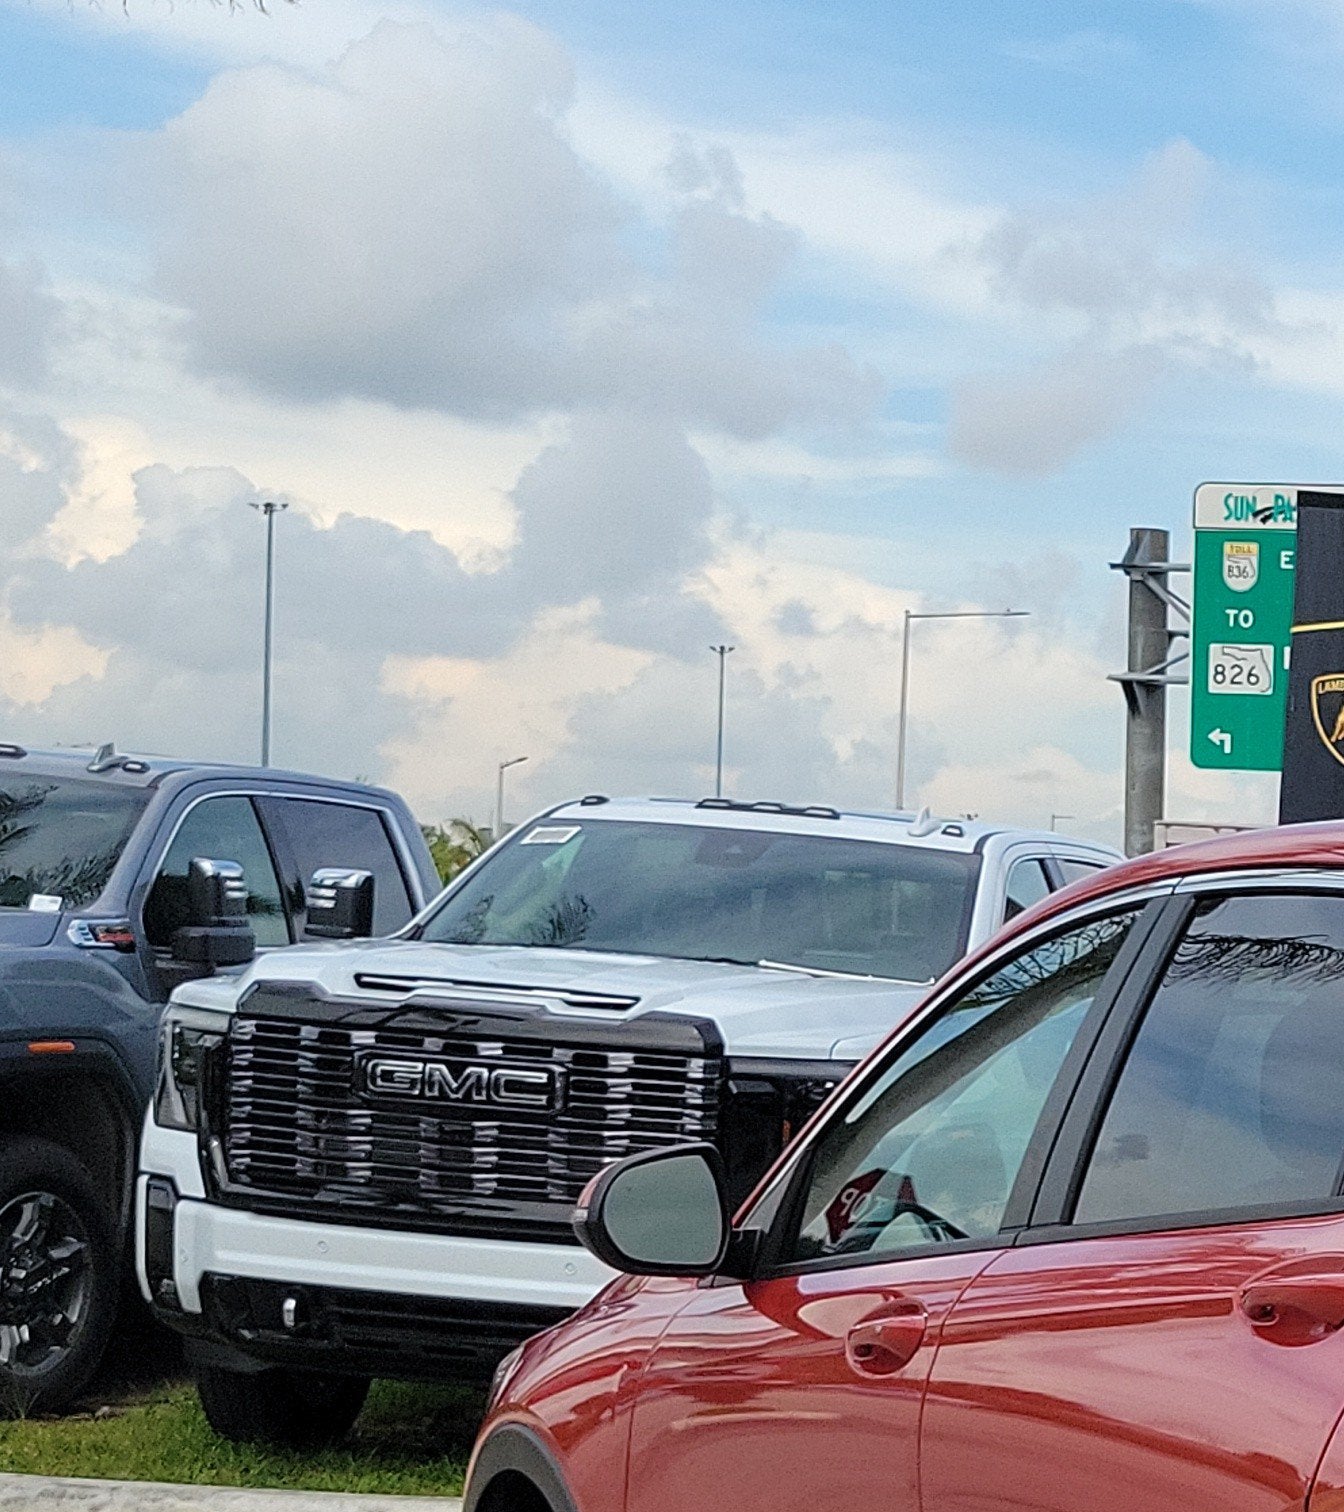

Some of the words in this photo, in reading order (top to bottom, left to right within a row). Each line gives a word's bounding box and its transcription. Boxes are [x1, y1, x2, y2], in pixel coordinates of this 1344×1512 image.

[1274, 494, 1297, 522] PA
[1228, 565, 1249, 579] 836
[1225, 609, 1254, 629] TO
[1213, 664, 1260, 686] 826
[367, 1058, 549, 1106] GMC
